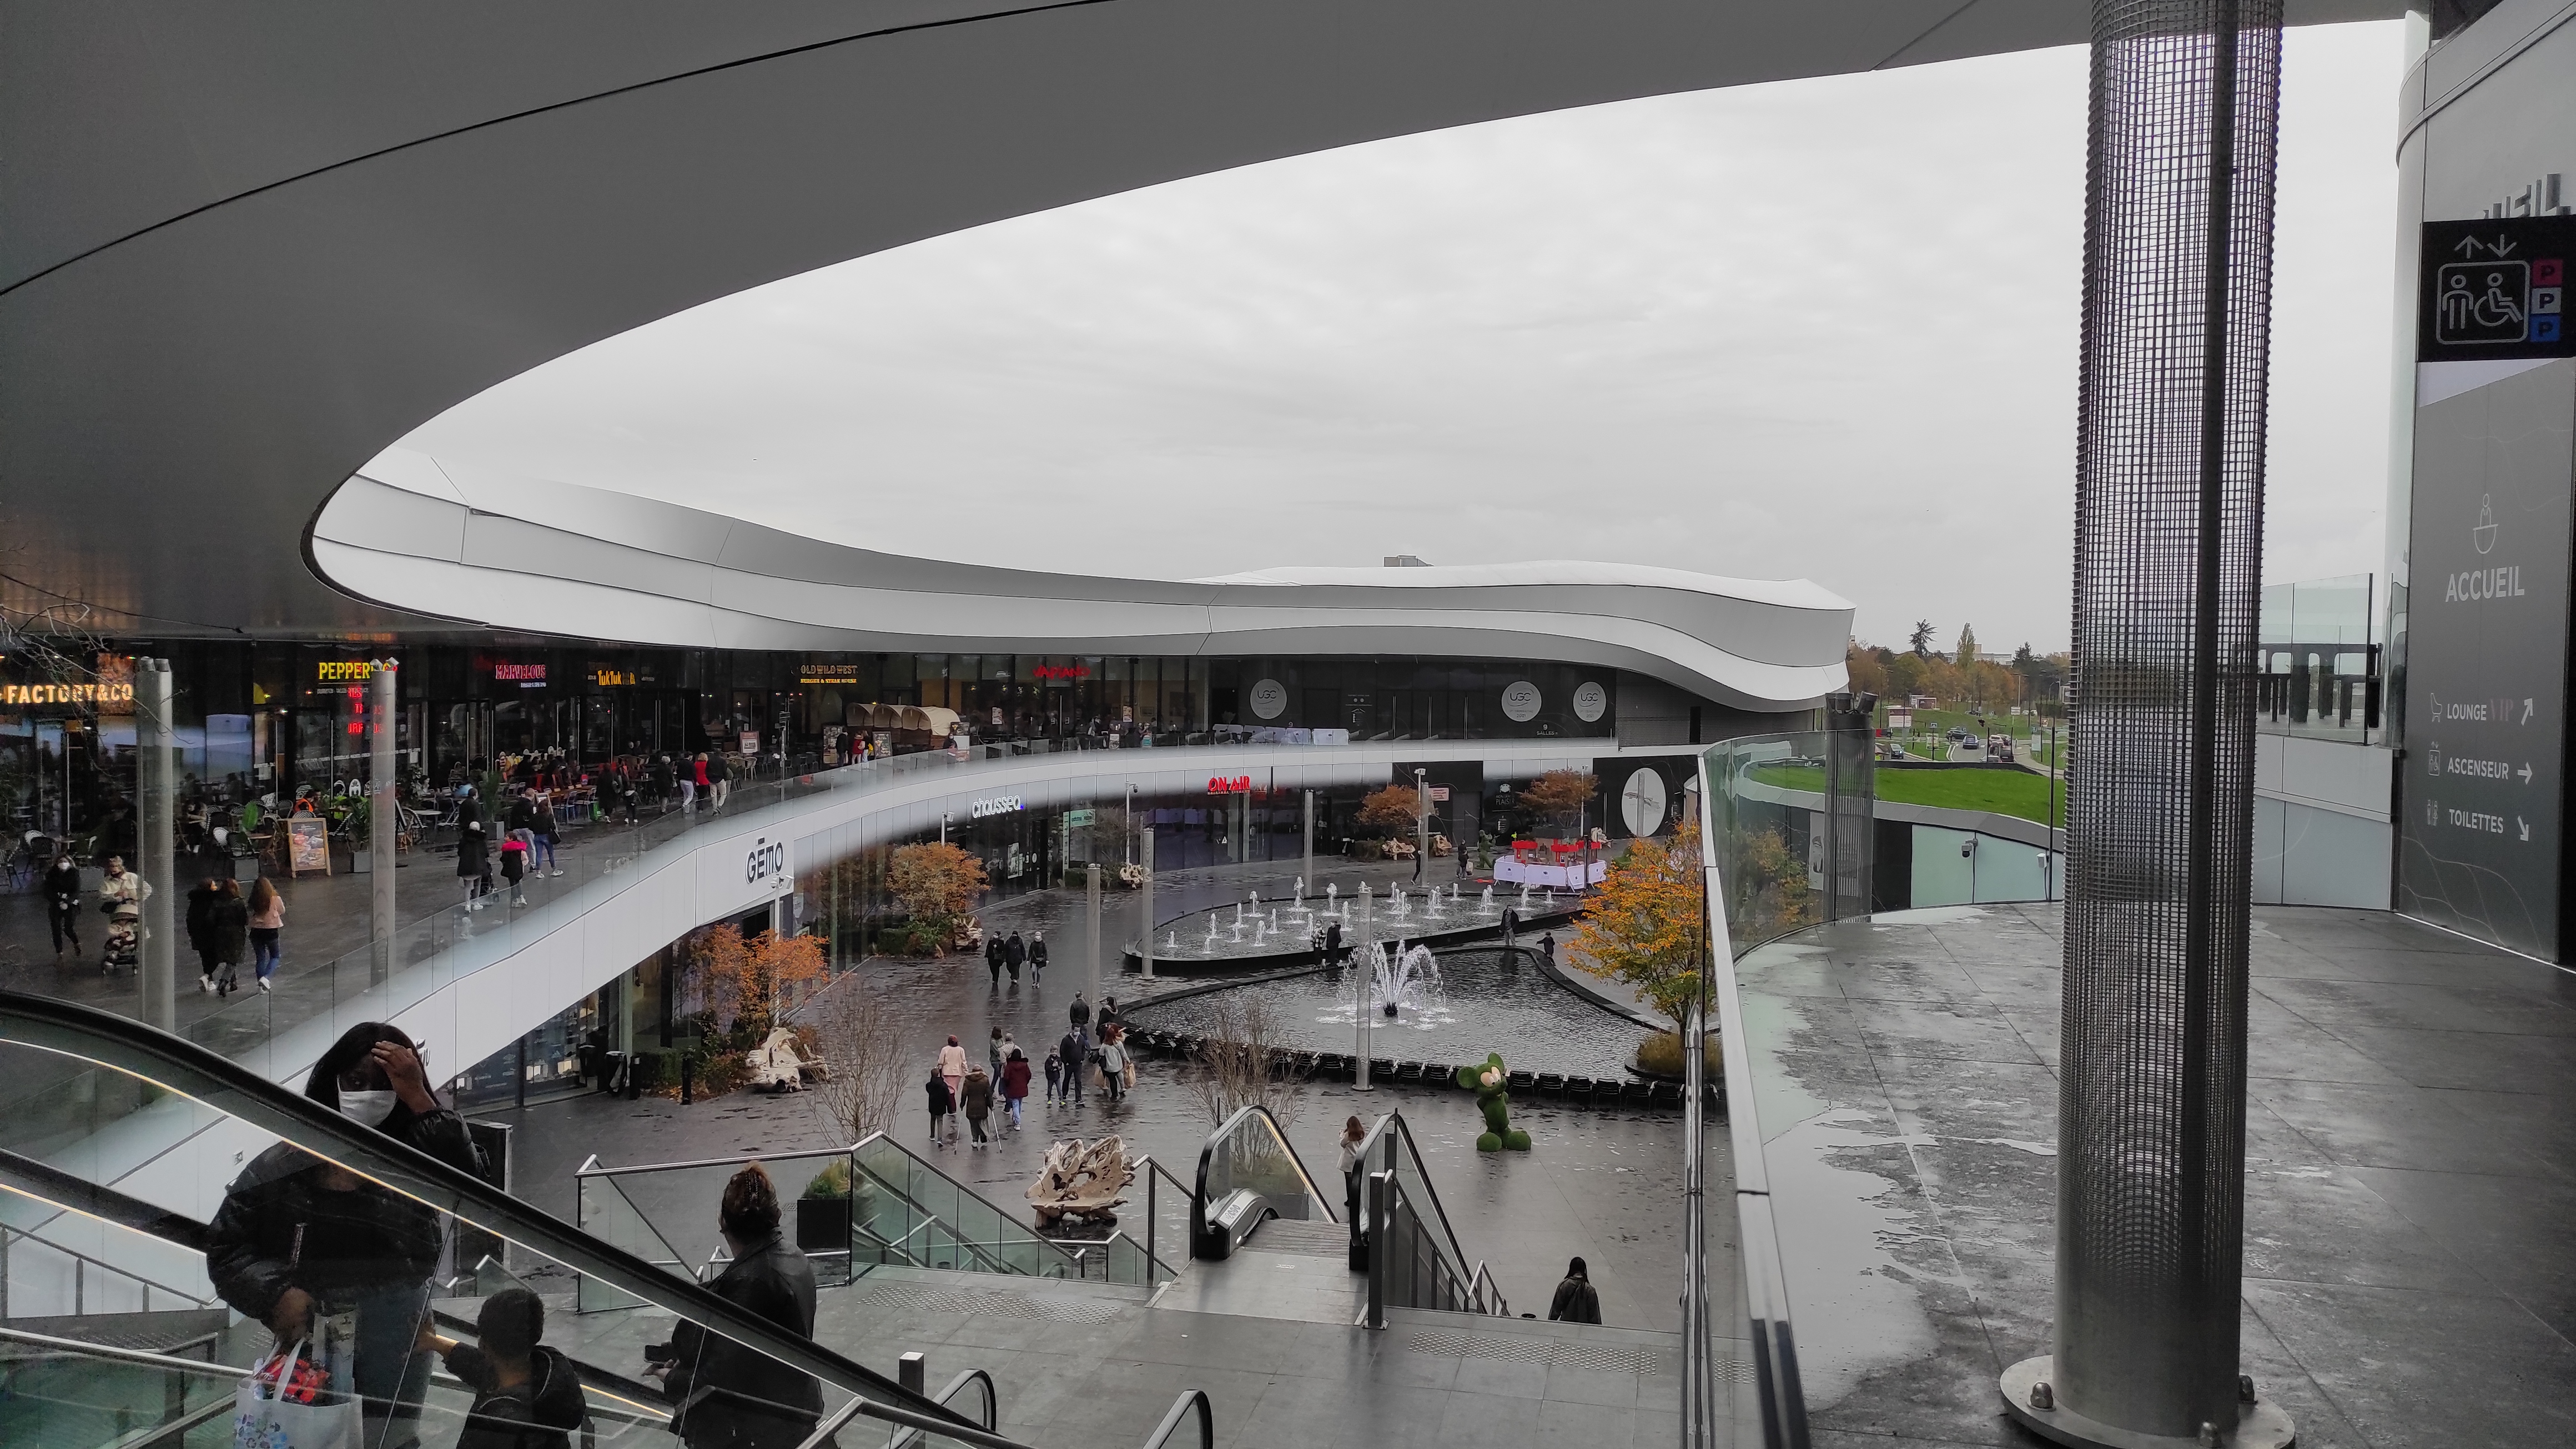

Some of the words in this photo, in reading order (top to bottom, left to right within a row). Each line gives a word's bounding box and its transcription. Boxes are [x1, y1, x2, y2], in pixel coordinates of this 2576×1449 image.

[2539, 293, 2554, 309] P
[2445, 566, 2524, 602] ACCUEIL
[496, 665, 546, 679] MARVELOUS
[801, 665, 816, 674] OLD
[837, 665, 858, 674] WEST
[1257, 690, 1276, 699] UGC
[1510, 692, 1531, 701] UGC
[1581, 693, 1598, 702] UGC
[2447, 703, 2487, 721] LOUNGE
[2490, 698, 2513, 722] VIP
[2447, 757, 2509, 779] ASCENSEUR
[1208, 777, 1227, 792] ON
[1229, 775, 1251, 791] AIR
[2449, 808, 2503, 833] TOILETTES
